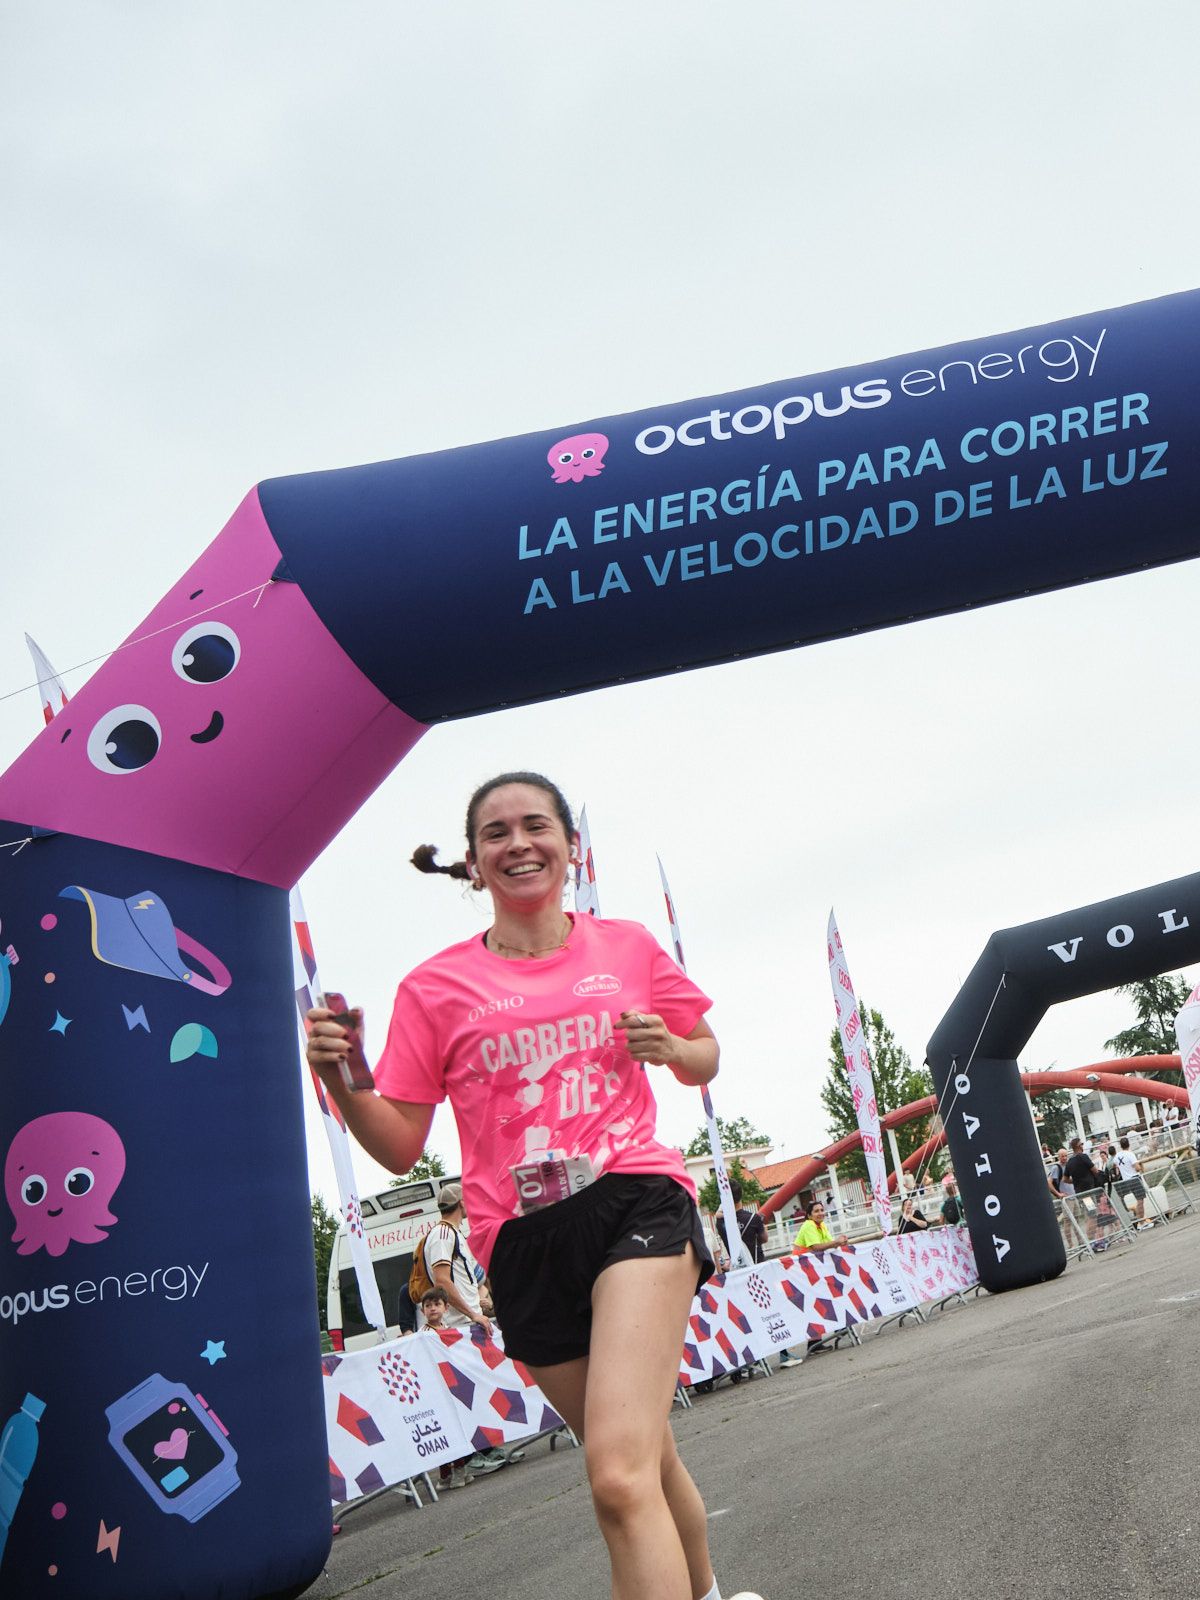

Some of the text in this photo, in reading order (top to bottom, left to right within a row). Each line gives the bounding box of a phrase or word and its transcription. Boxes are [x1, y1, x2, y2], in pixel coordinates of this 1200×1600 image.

[634, 328, 1107, 455] octopus energy
[518, 391, 1150, 560] LA ENERGÍA PARA CORRER
[523, 441, 1170, 614] A LA VELOCIDAD DE LA LUZ
[468, 995, 524, 1022] OYSHO
[480, 1010, 616, 1073] CARRERA
[955, 1073, 1011, 1263] VOLVO
[75, 1262, 209, 1304] energy
[771, 1329, 791, 1344] OMAN
[403, 1409, 435, 1424] Experience
[417, 1435, 450, 1457] OMAN
